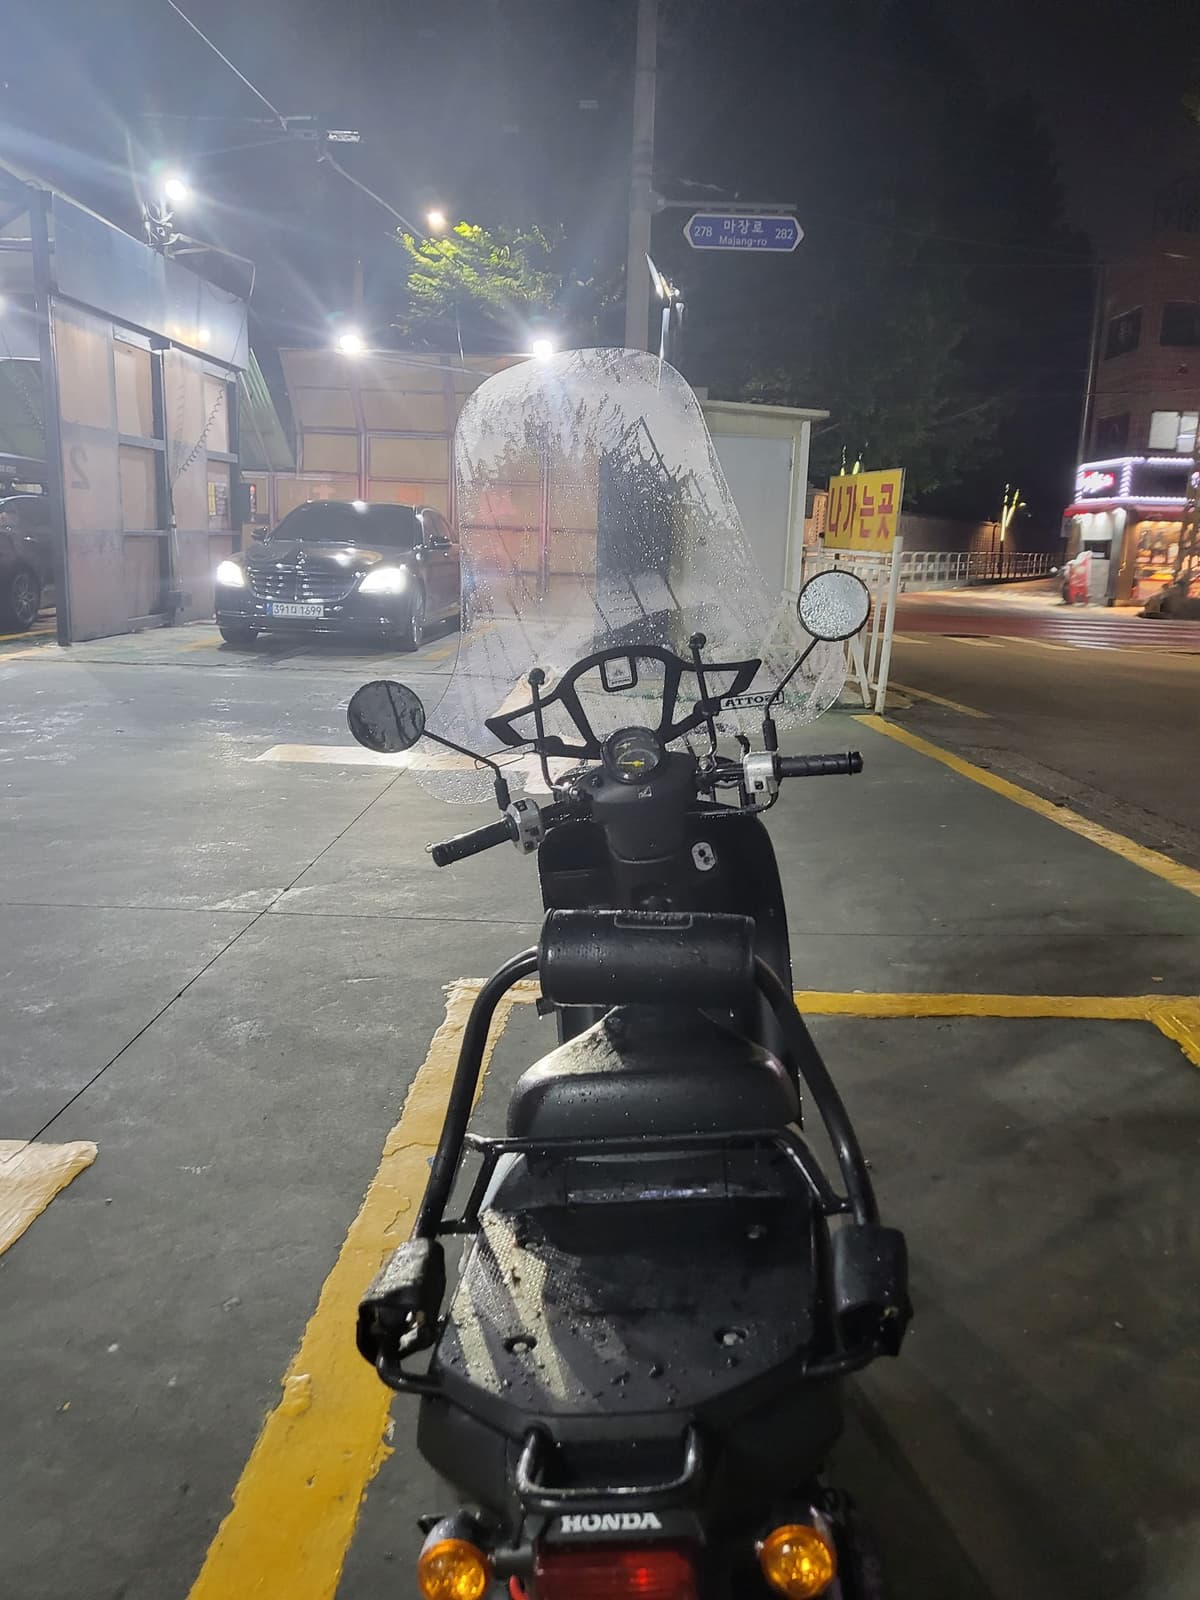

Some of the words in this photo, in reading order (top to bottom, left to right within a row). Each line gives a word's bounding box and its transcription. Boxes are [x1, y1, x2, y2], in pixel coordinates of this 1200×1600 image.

[694, 225, 713, 238] 278
[723, 219, 764, 234] 마장로
[775, 228, 794, 240] 282
[719, 235, 768, 248] Majang-ro
[828, 482, 894, 539] 나가는곳
[300, 606, 322, 616] 1699
[560, 1512, 662, 1533] HONDA
